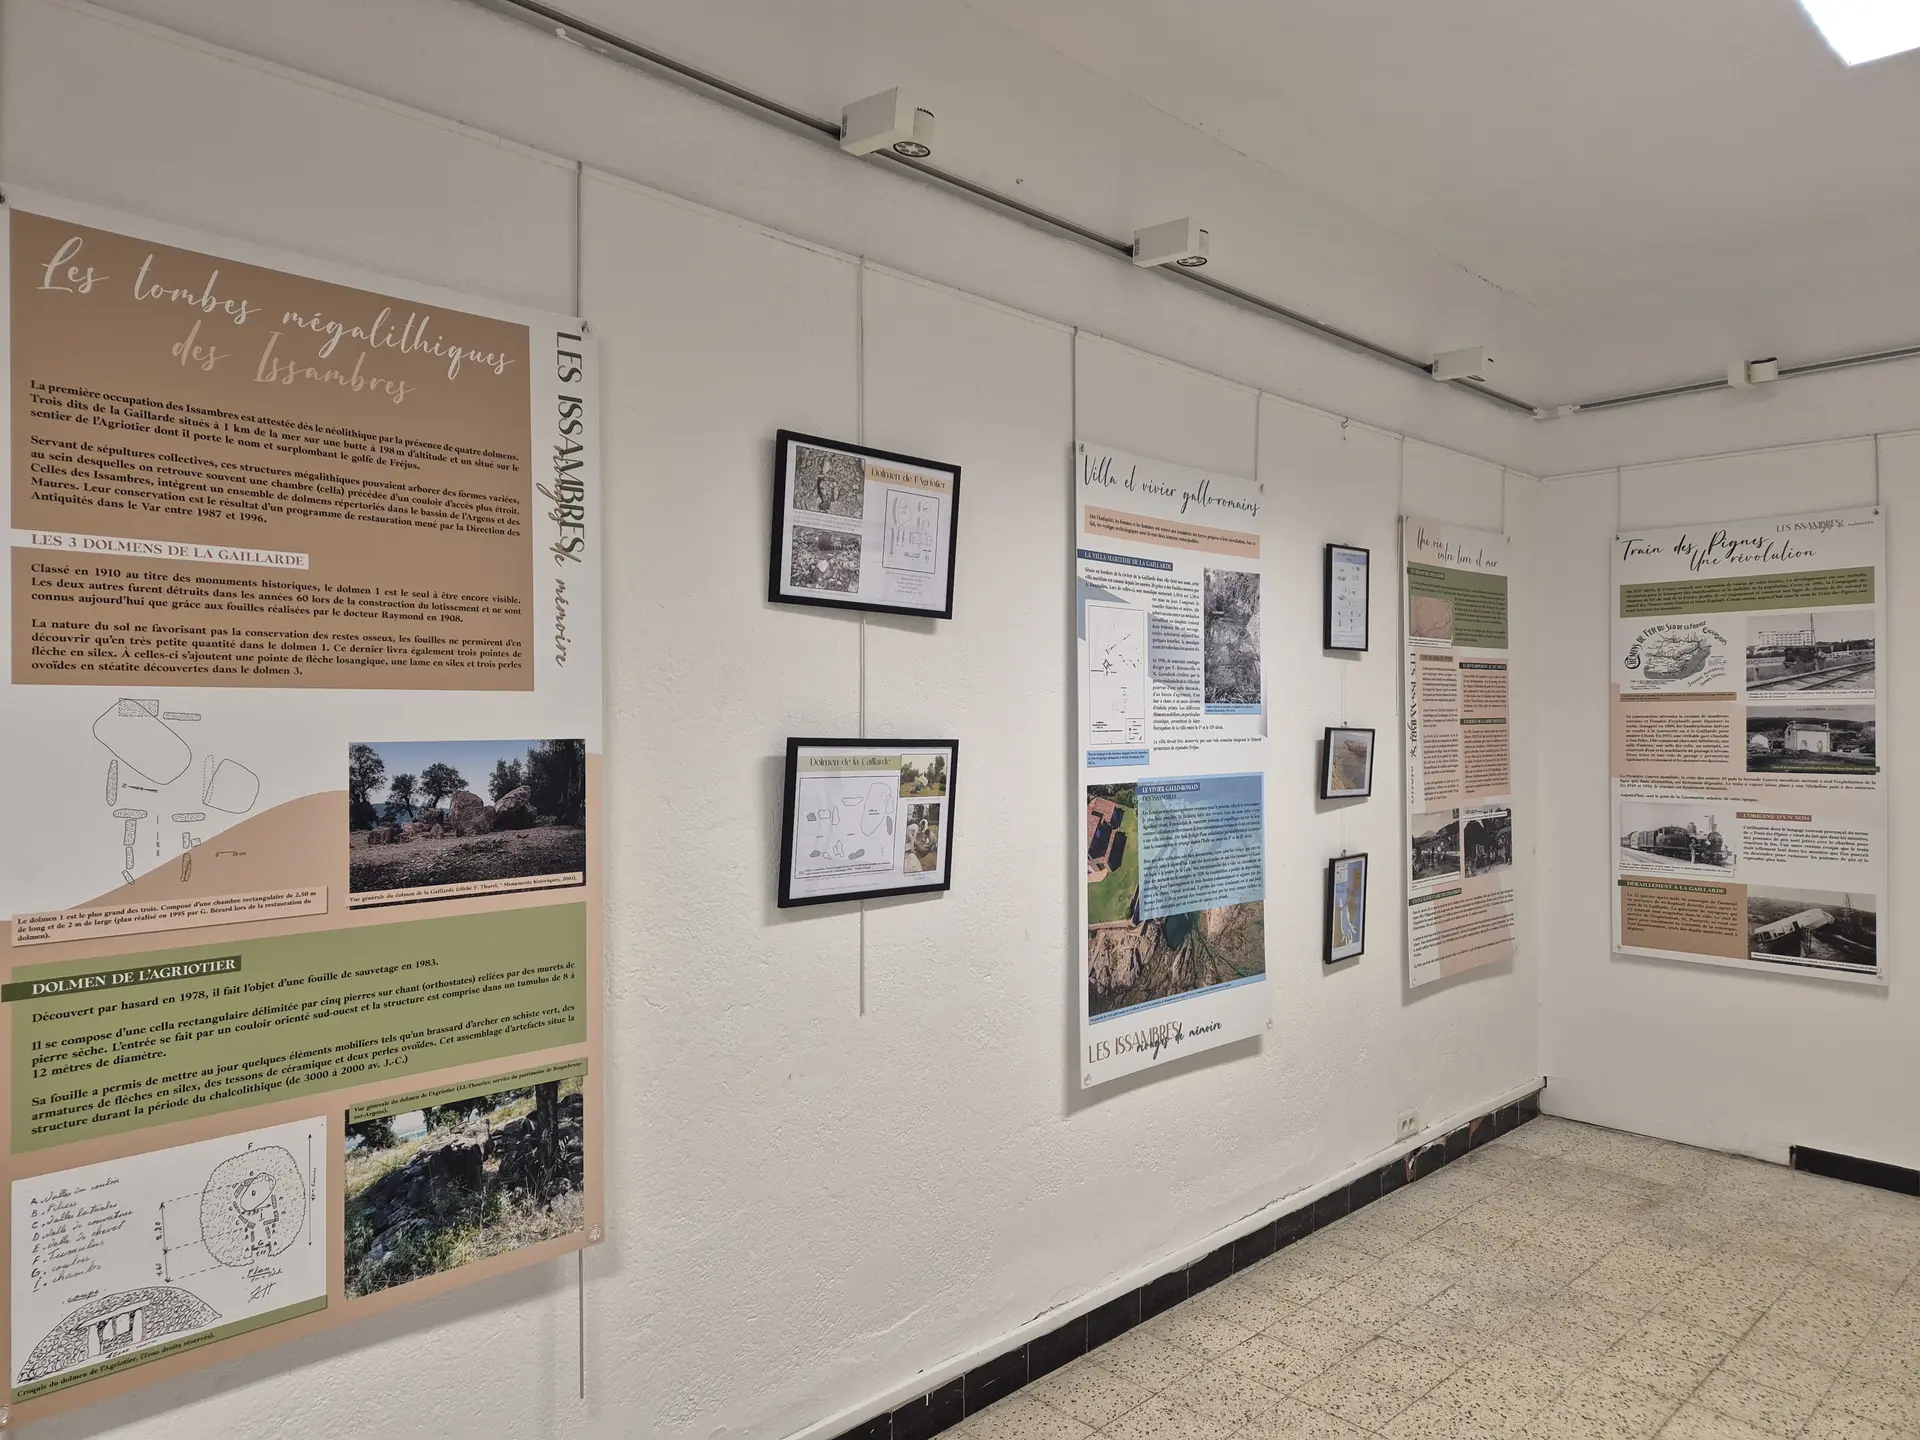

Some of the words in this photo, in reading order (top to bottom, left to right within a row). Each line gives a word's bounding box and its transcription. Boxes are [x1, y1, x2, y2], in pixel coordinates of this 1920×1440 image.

[36, 236, 110, 294] Les
[134, 254, 262, 325] tombes
[282, 307, 516, 381] mégalithiques
[172, 319, 230, 371] des
[253, 330, 416, 404] Issambres
[556, 331, 582, 384] LES
[30, 379, 46, 390] La
[47, 384, 101, 399] première
[102, 393, 164, 409] occupation
[165, 400, 184, 411] des
[185, 403, 239, 420] Issambres
[240, 414, 255, 423] est
[256, 416, 296, 429] attestée
[296, 420, 314, 431] dès
[314, 423, 324, 433] le
[324, 427, 377, 442] néolithique
[378, 435, 394, 444] par
[394, 435, 403, 444] la
[404, 438, 442, 450] présence
[442, 443, 453, 452] de
[453, 446, 481, 456] quatre
[481, 448, 519, 461] dolmens.
[557, 394, 585, 553] ISSAMBRES
[872, 468, 900, 480] Dolmen
[903, 474, 912, 482] de
[1084, 454, 1117, 488] Villa
[1142, 480, 1176, 497] vivier
[1621, 538, 1664, 561] Train
[1673, 534, 1698, 555] des
[1708, 529, 1770, 559] Pignes
[1776, 524, 1792, 532] LES
[31, 533, 62, 546] LES
[67, 536, 77, 547] 3
[83, 537, 162, 554] DOLMENS
[167, 544, 189, 556] DE
[193, 547, 213, 559] LA
[217, 549, 304, 566] GAILLARDE
[1690, 548, 1722, 572] Une
[1730, 540, 1817, 564] révolution
[30, 563, 70, 574] Classé
[94, 567, 121, 578] 1910
[143, 570, 168, 581] titre
[172, 572, 191, 582] des
[195, 576, 258, 587] monuments
[261, 578, 320, 592] historiques,
[324, 583, 333, 592] le
[335, 584, 371, 594] dolmen
[375, 587, 379, 595] 1
[400, 588, 409, 597] le
[411, 590, 430, 598] seul
[491, 594, 521, 604] visible.
[810, 758, 839, 766] Dolmen
[842, 758, 851, 766] de
[31, 1006, 94, 1023] Découvert
[97, 1004, 118, 1016] par
[120, 996, 159, 1010] hasard
[161, 996, 176, 1004] en
[180, 990, 209, 1002] 1978,
[212, 987, 220, 997] il
[223, 985, 240, 996] fait
[243, 981, 274, 993] l'objet
[277, 977, 305, 988] d'une
[307, 971, 338, 983] fouille
[340, 970, 352, 979] de
[354, 965, 399, 976] sauvetage
[415, 958, 439, 968] 1983.
[32, 974, 106, 995] DOLMEN
[111, 971, 134, 984] DE
[138, 958, 236, 981] L'AGRIOTIER
[1088, 1040, 1110, 1064] LES
[1115, 1020, 1179, 1055] ISSAMBRES
[32, 1067, 47, 1078] 12
[51, 1062, 92, 1075] mètres
[95, 1057, 109, 1068] de
[112, 1050, 167, 1065] diamètre.
[16, 1383, 47, 1397] Croquis
[59, 1372, 88, 1384] dolmen
[99, 1356, 138, 1372] l'Agriotier,
[139, 1350, 160, 1360] (Tous
[160, 1343, 182, 1353] droits
[182, 1332, 215, 1346] réservés).
